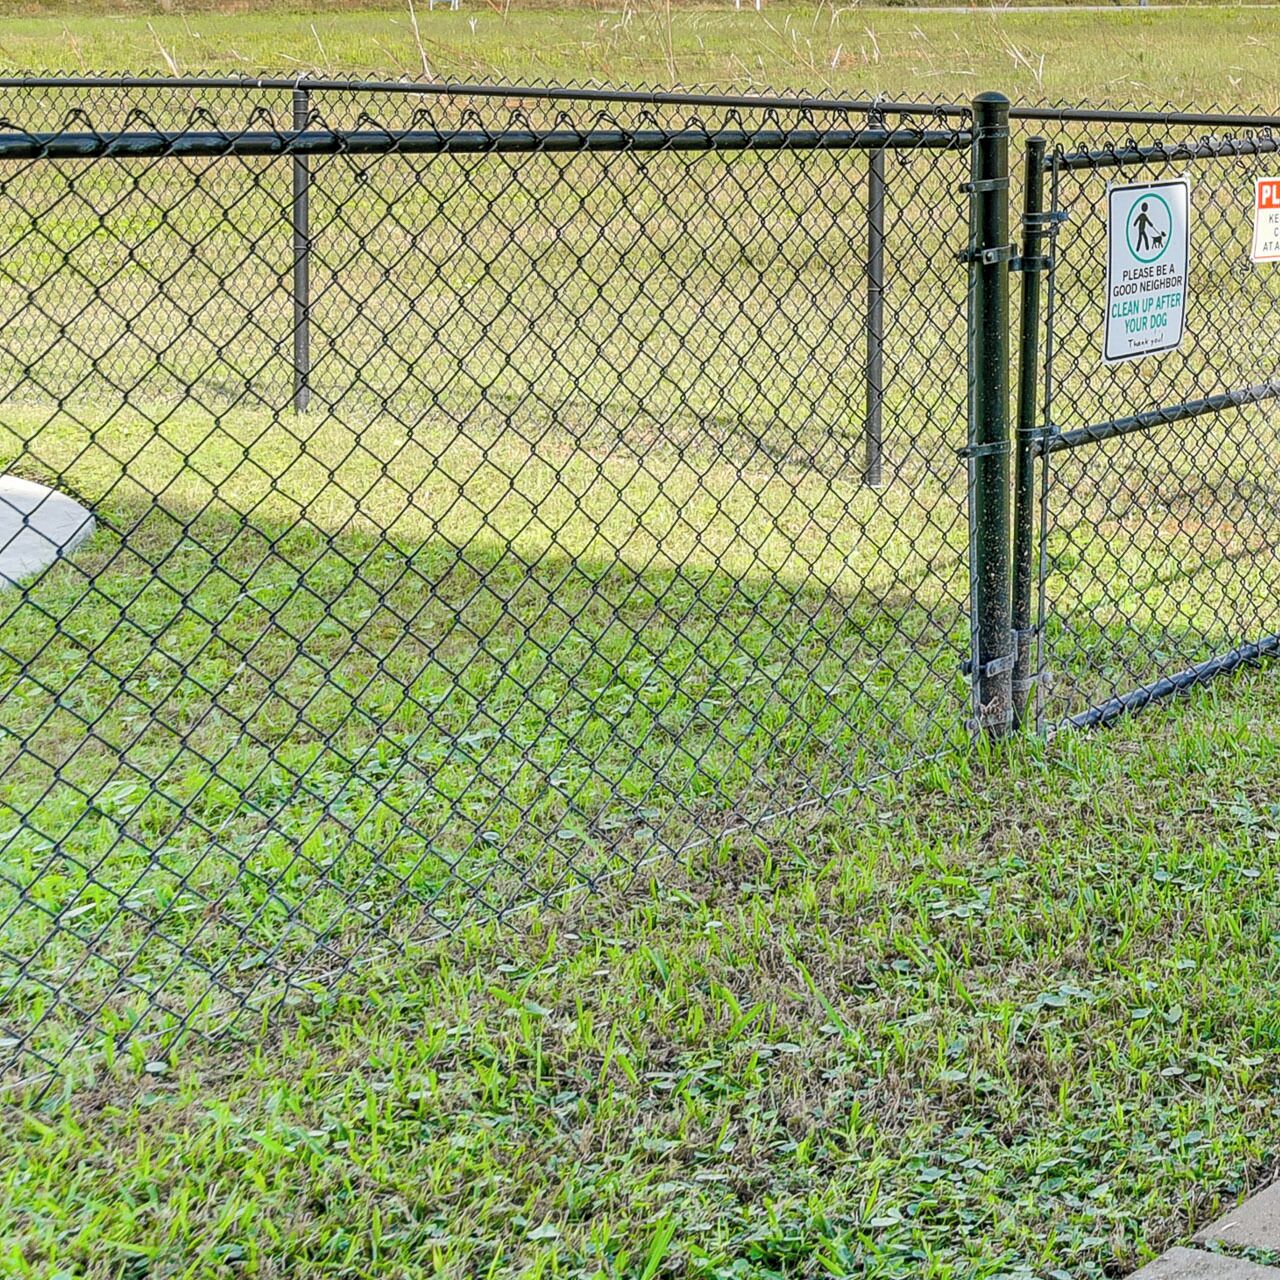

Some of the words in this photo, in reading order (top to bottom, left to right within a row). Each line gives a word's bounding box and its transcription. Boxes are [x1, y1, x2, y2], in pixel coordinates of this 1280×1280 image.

[1263, 241, 1273, 252] AT
[1122, 266, 1154, 282] PLEASE
[1156, 264, 1167, 276] BE
[1169, 264, 1175, 274] A
[1113, 283, 1137, 297] GOOD
[1140, 276, 1182, 293] NEIGHBOR
[1112, 300, 1139, 318] CLEAN
[1142, 297, 1154, 313] UP
[1156, 292, 1181, 310] AFTER
[1125, 316, 1148, 334] YOUR
[1150, 312, 1167, 329] DOG
[1128, 338, 1148, 348] Thank
